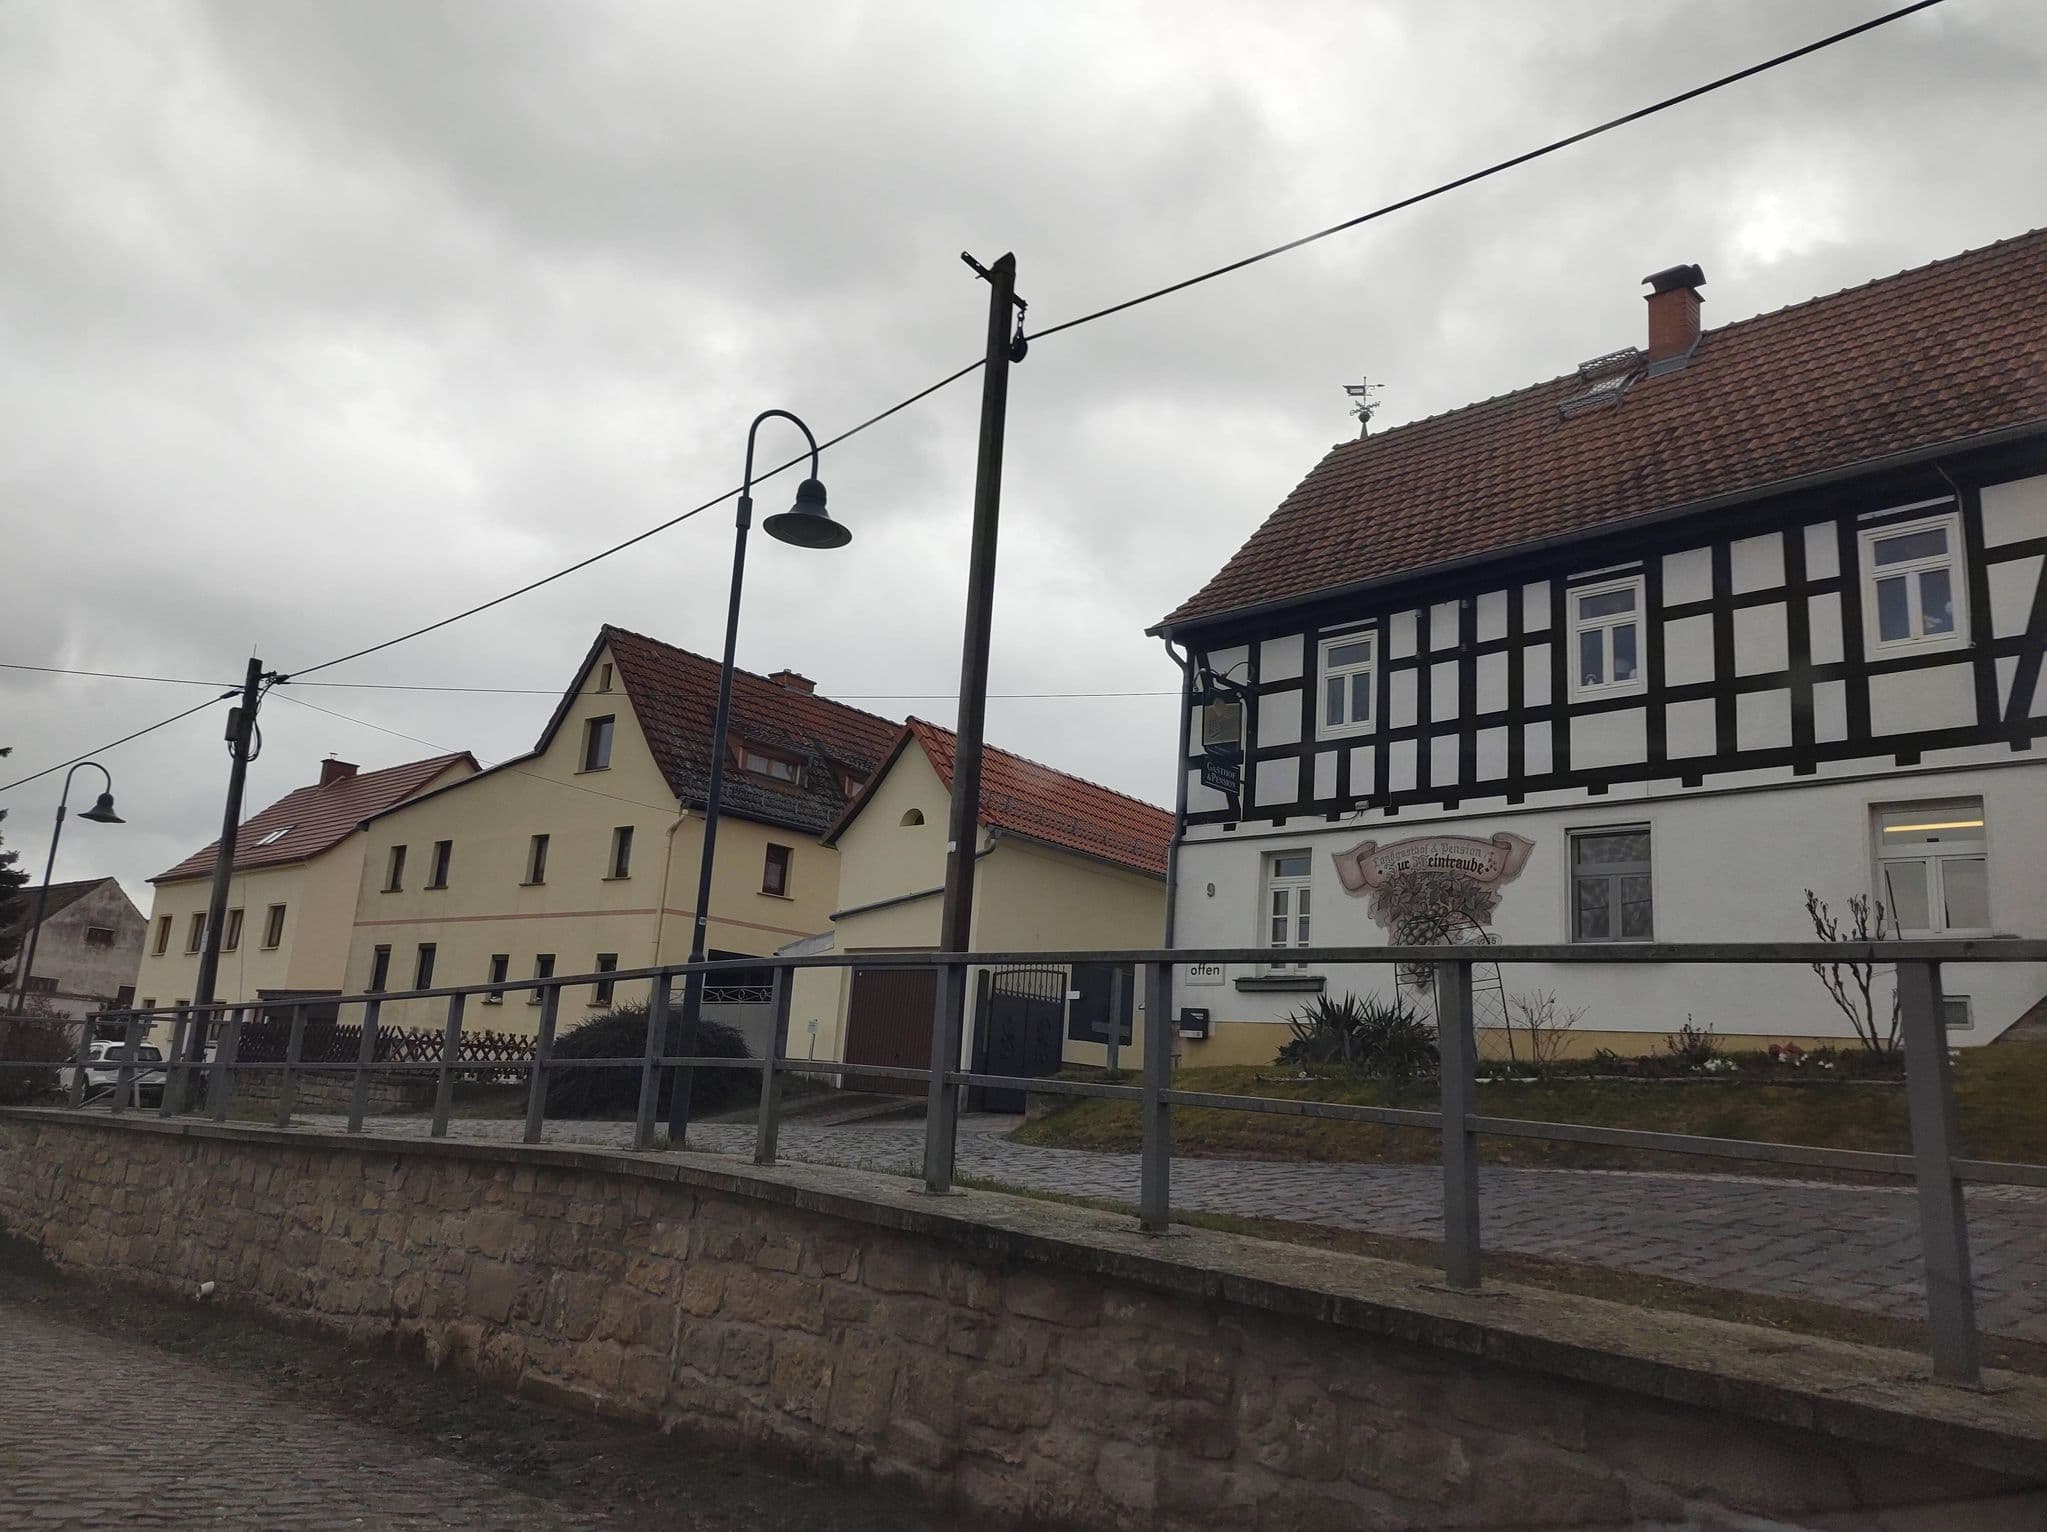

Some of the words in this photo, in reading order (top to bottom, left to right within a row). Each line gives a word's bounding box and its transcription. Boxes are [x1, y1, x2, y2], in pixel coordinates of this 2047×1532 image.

[1207, 761, 1237, 779] GASTHOF
[1441, 842, 1482, 857] Pension
[1384, 858, 1410, 874] Zur
[1412, 852, 1484, 875] Weintraube
[1206, 882, 1216, 898] 9
[1190, 963, 1220, 976] offen
